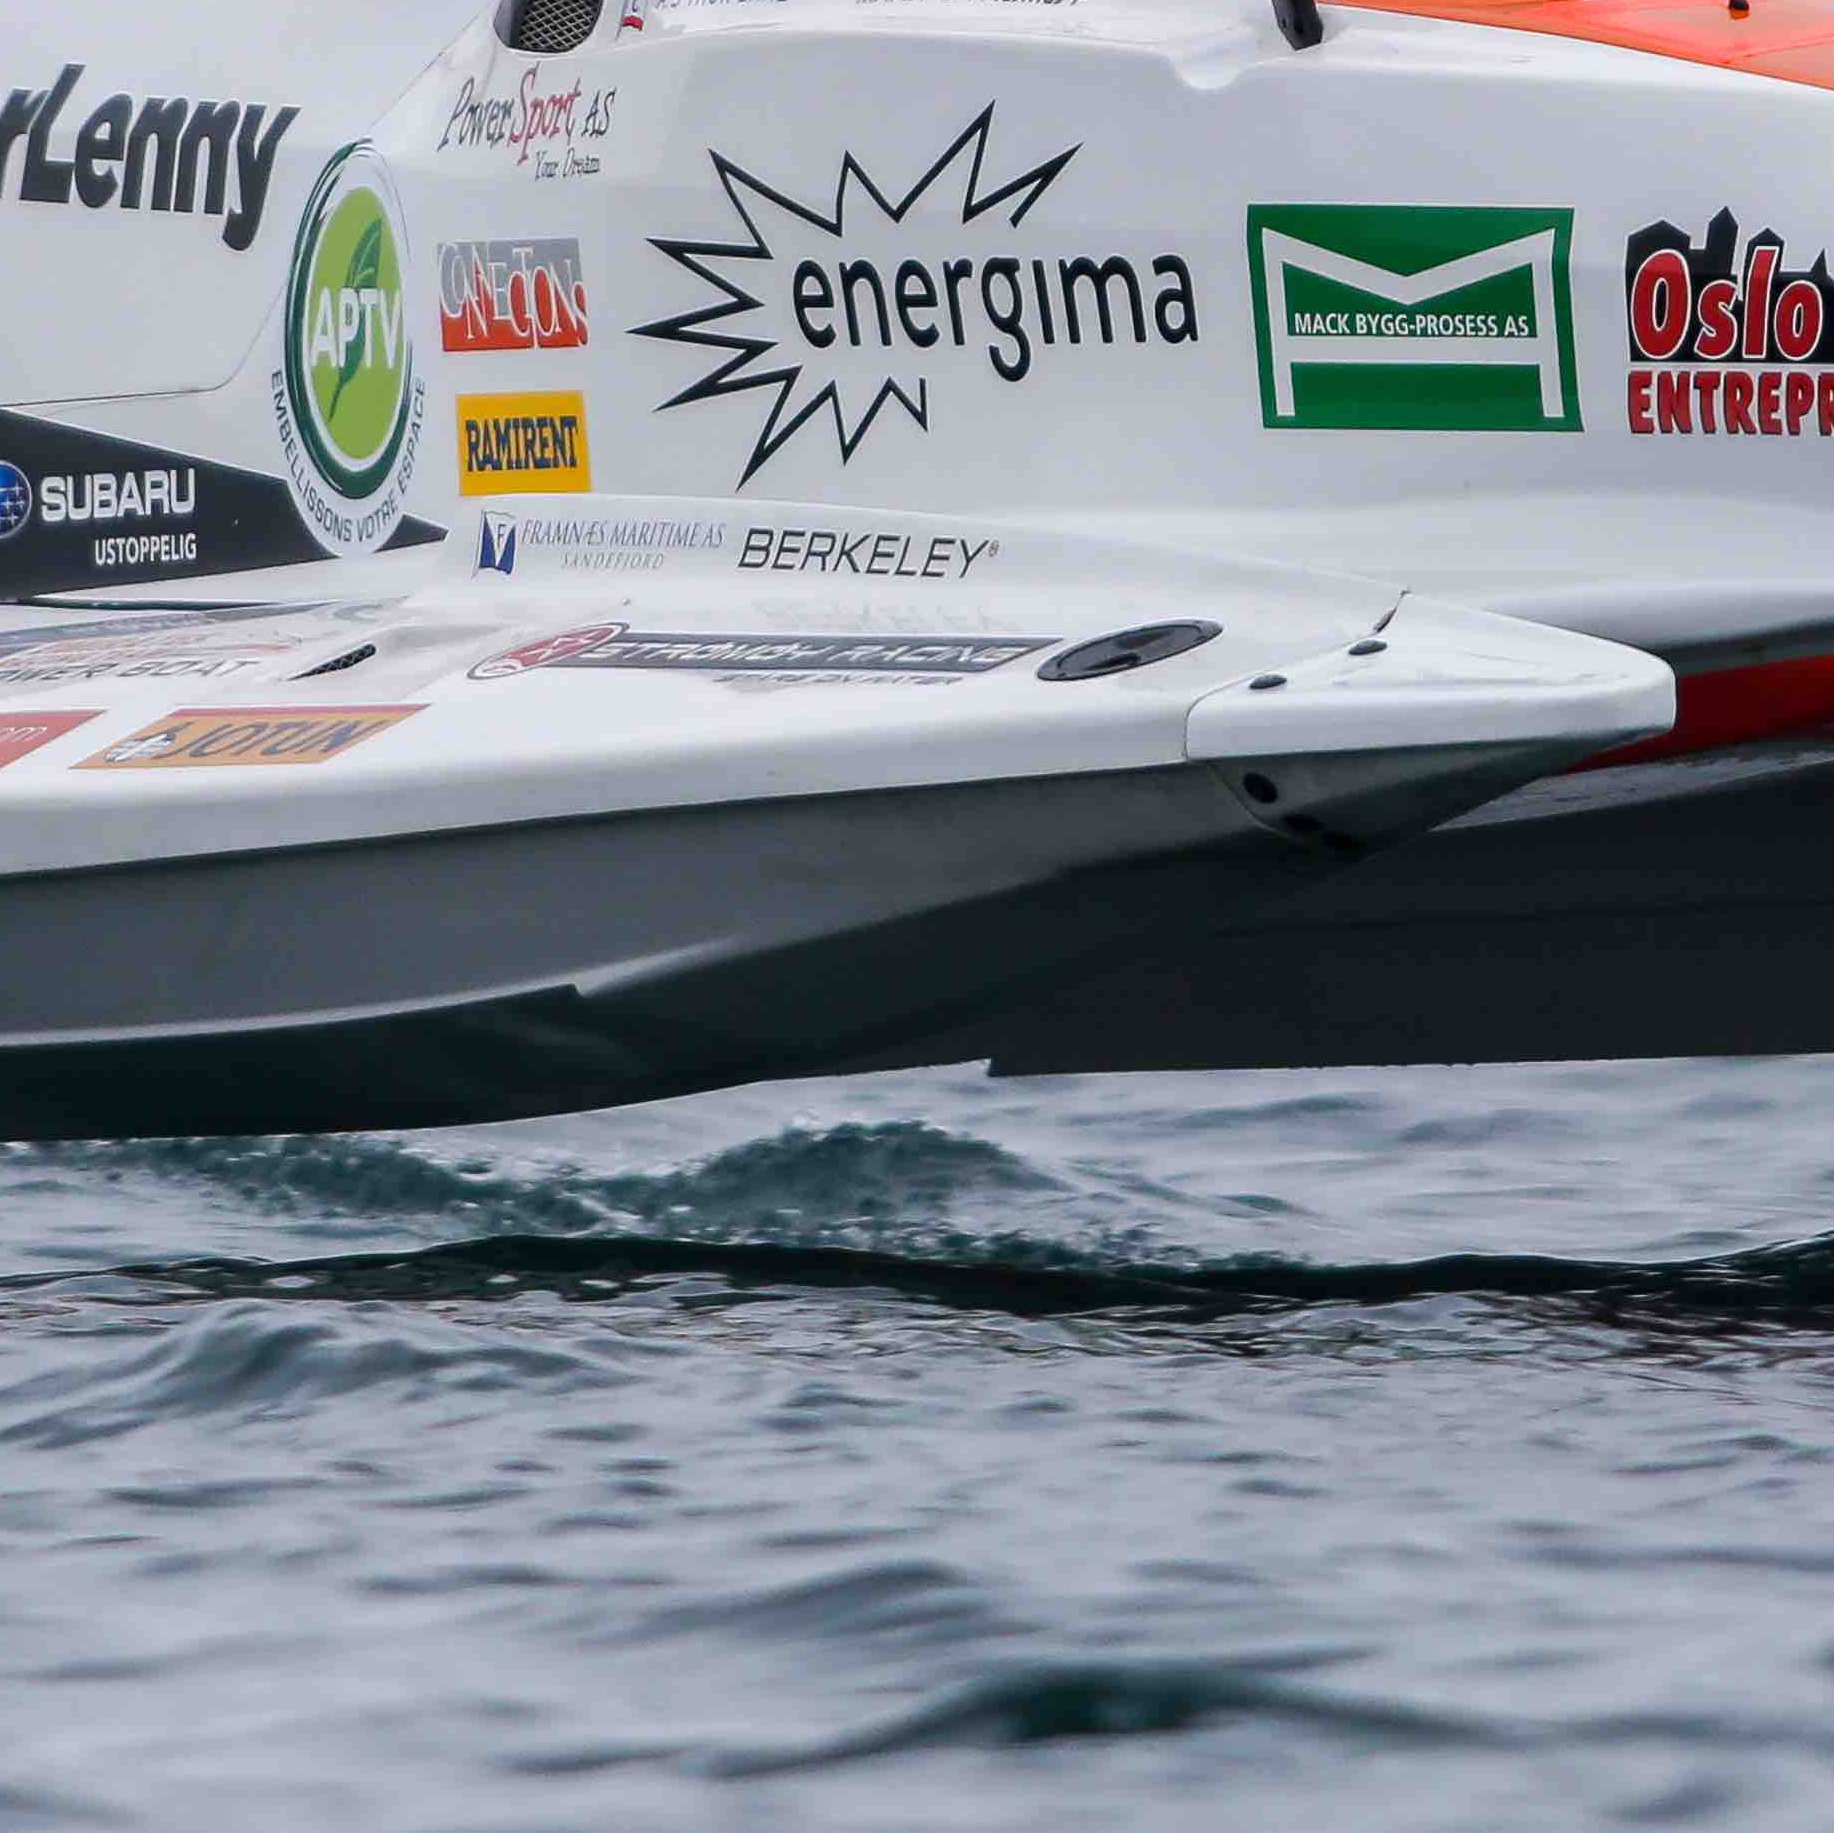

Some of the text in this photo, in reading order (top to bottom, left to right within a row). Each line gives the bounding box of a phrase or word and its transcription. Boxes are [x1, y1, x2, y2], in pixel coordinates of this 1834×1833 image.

[581, 85, 617, 138] AS
[309, 285, 404, 369] APTV
[792, 253, 1199, 382] energima
[1293, 312, 1529, 337] MACK BYGG-PROSESS AS
[1631, 247, 1823, 359] Oslo
[270, 369, 426, 543] EMBELLISSONS VOTRE ESPACE
[465, 414, 578, 472] RAMIRENT
[40, 469, 197, 522] SUBARU
[94, 534, 198, 565] USTOPPELIG
[610, 519, 700, 548] MARITIME
[701, 522, 728, 549] AS
[119, 660, 261, 679] BOAT
[150, 719, 395, 760] JOTUN
